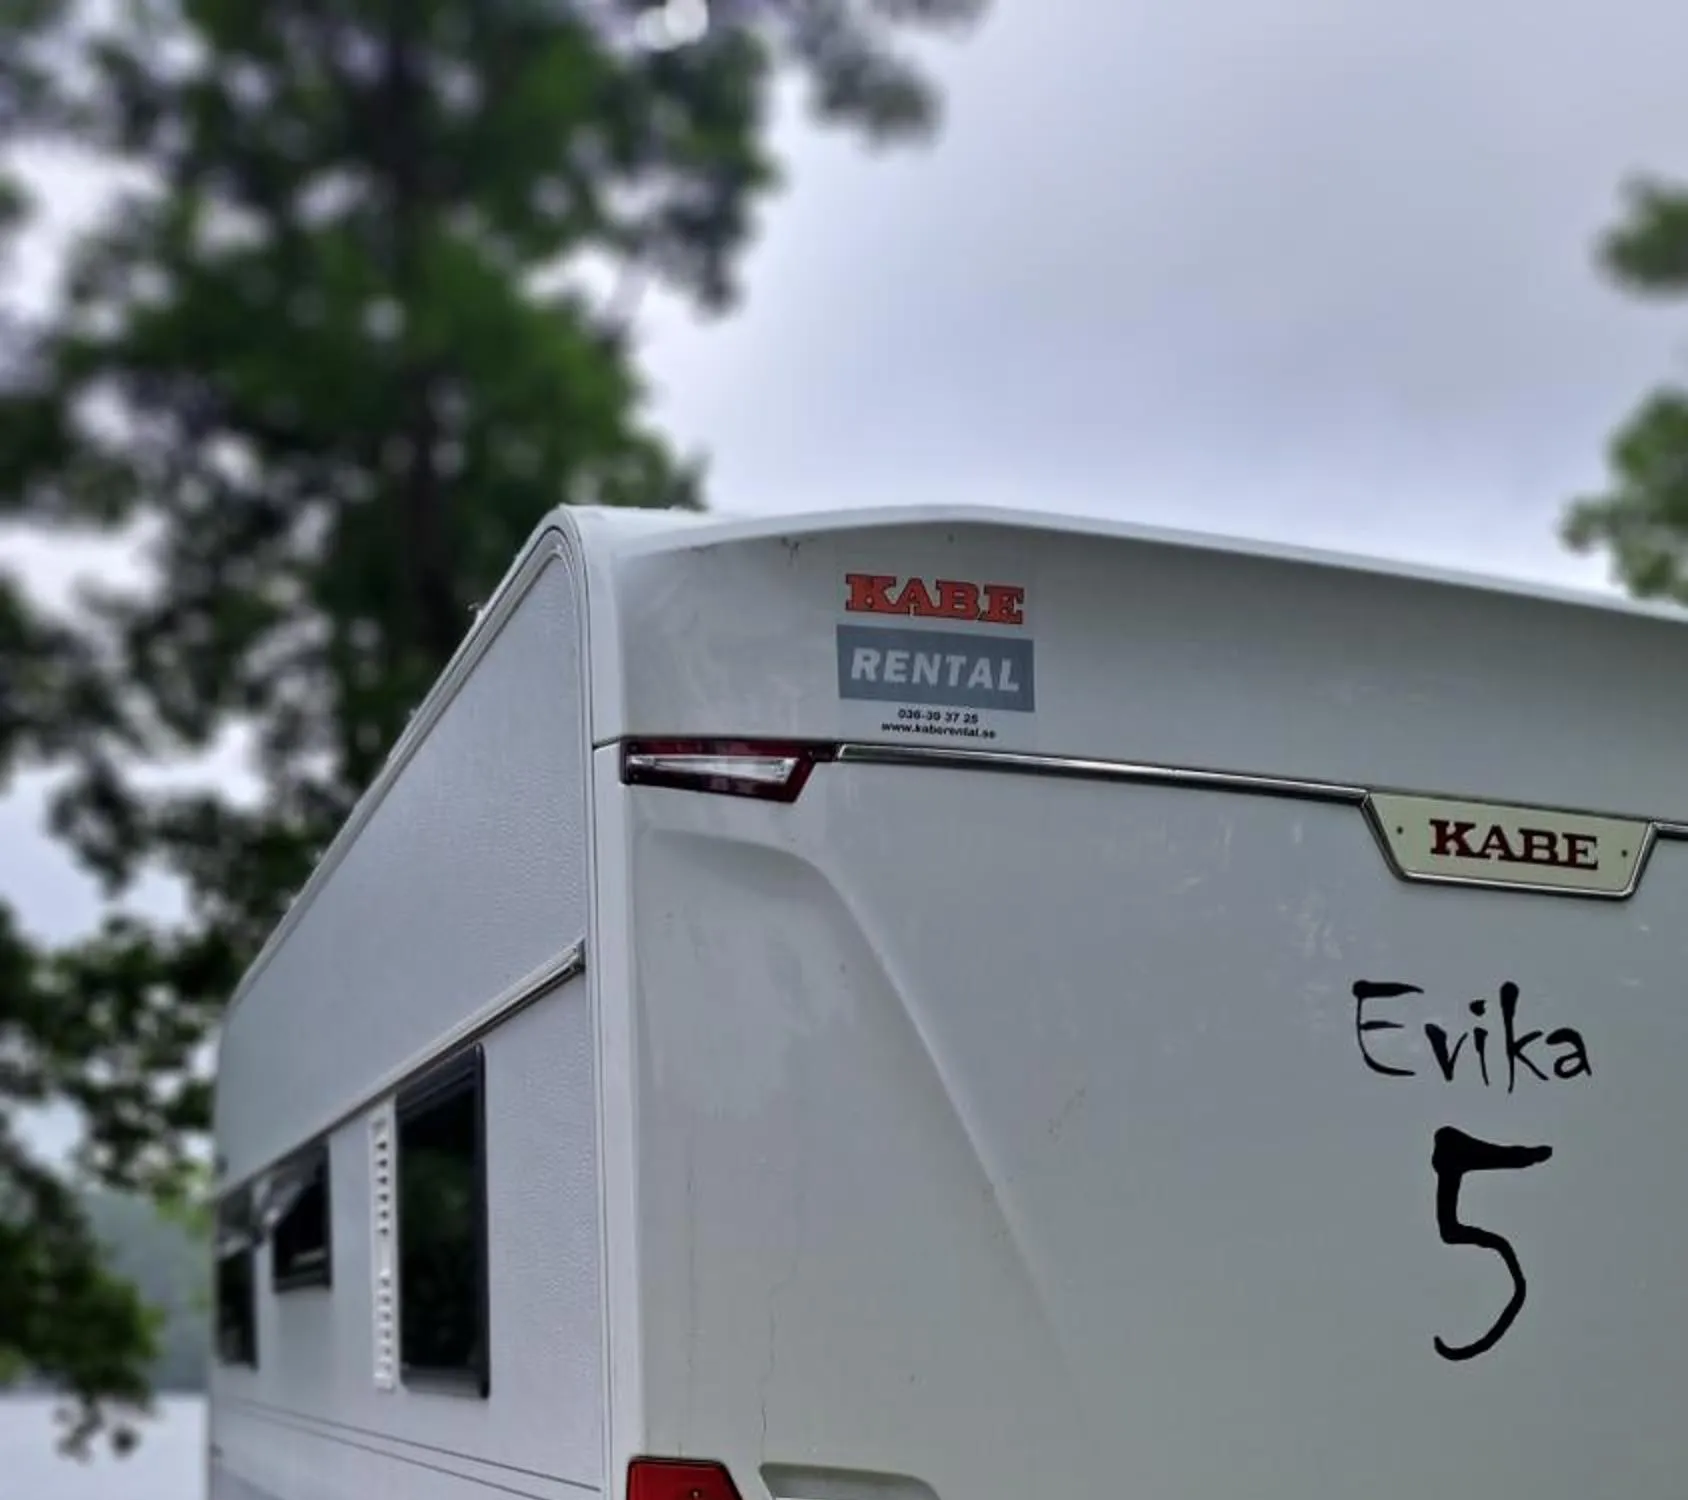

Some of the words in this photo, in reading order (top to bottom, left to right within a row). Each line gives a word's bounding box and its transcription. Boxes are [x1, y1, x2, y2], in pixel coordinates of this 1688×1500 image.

[845, 573, 1025, 625] KABE
[851, 647, 1020, 692] RENTAL
[881, 722, 996, 739] www.kaberental.se
[1429, 819, 1599, 870] KABE
[1431, 1126, 1553, 1360] 5
